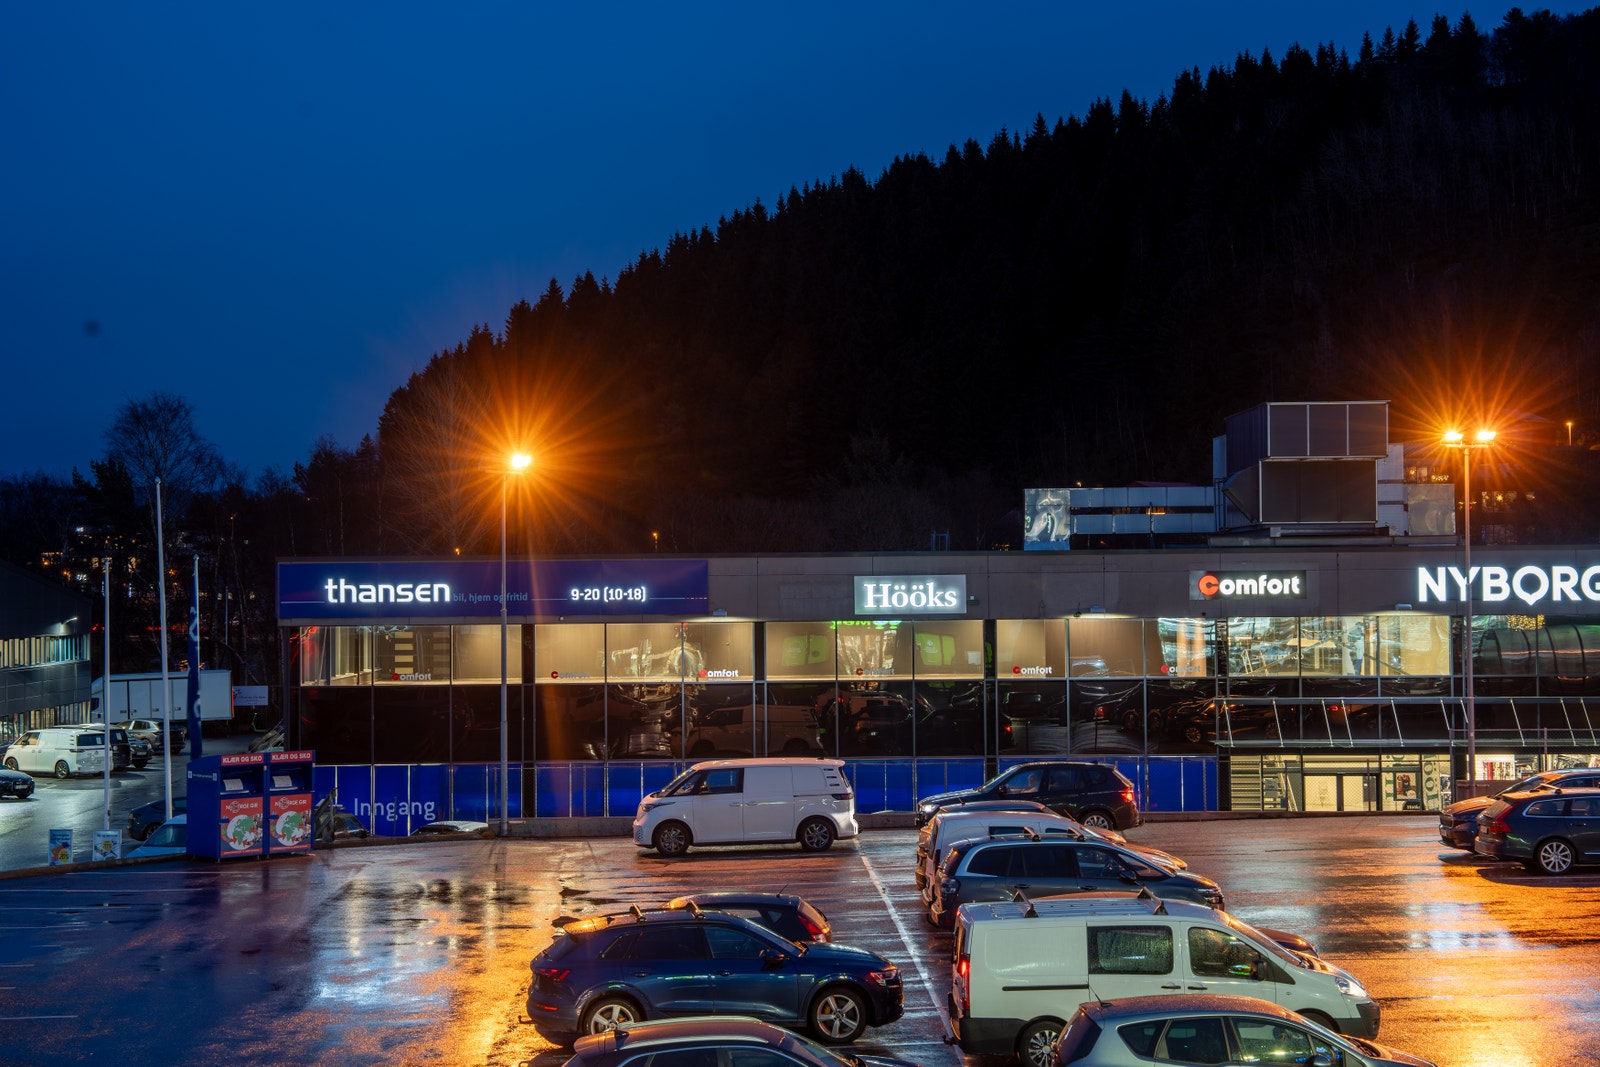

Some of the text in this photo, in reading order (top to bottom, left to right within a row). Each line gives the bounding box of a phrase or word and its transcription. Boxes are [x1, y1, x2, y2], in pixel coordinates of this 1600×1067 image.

[324, 578, 451, 604] thansen
[1198, 573, 1300, 597] Comfort
[453, 592, 467, 603] bil,
[469, 592, 491, 604] hjem
[507, 592, 528, 602] fritid
[571, 586, 646, 603] 9-20 (10-18)
[863, 581, 957, 608] Hööks
[391, 672, 432, 681] Comfort
[699, 668, 739, 678] Comfort
[1012, 665, 1052, 675] Comfort
[354, 797, 437, 822] Inngang
